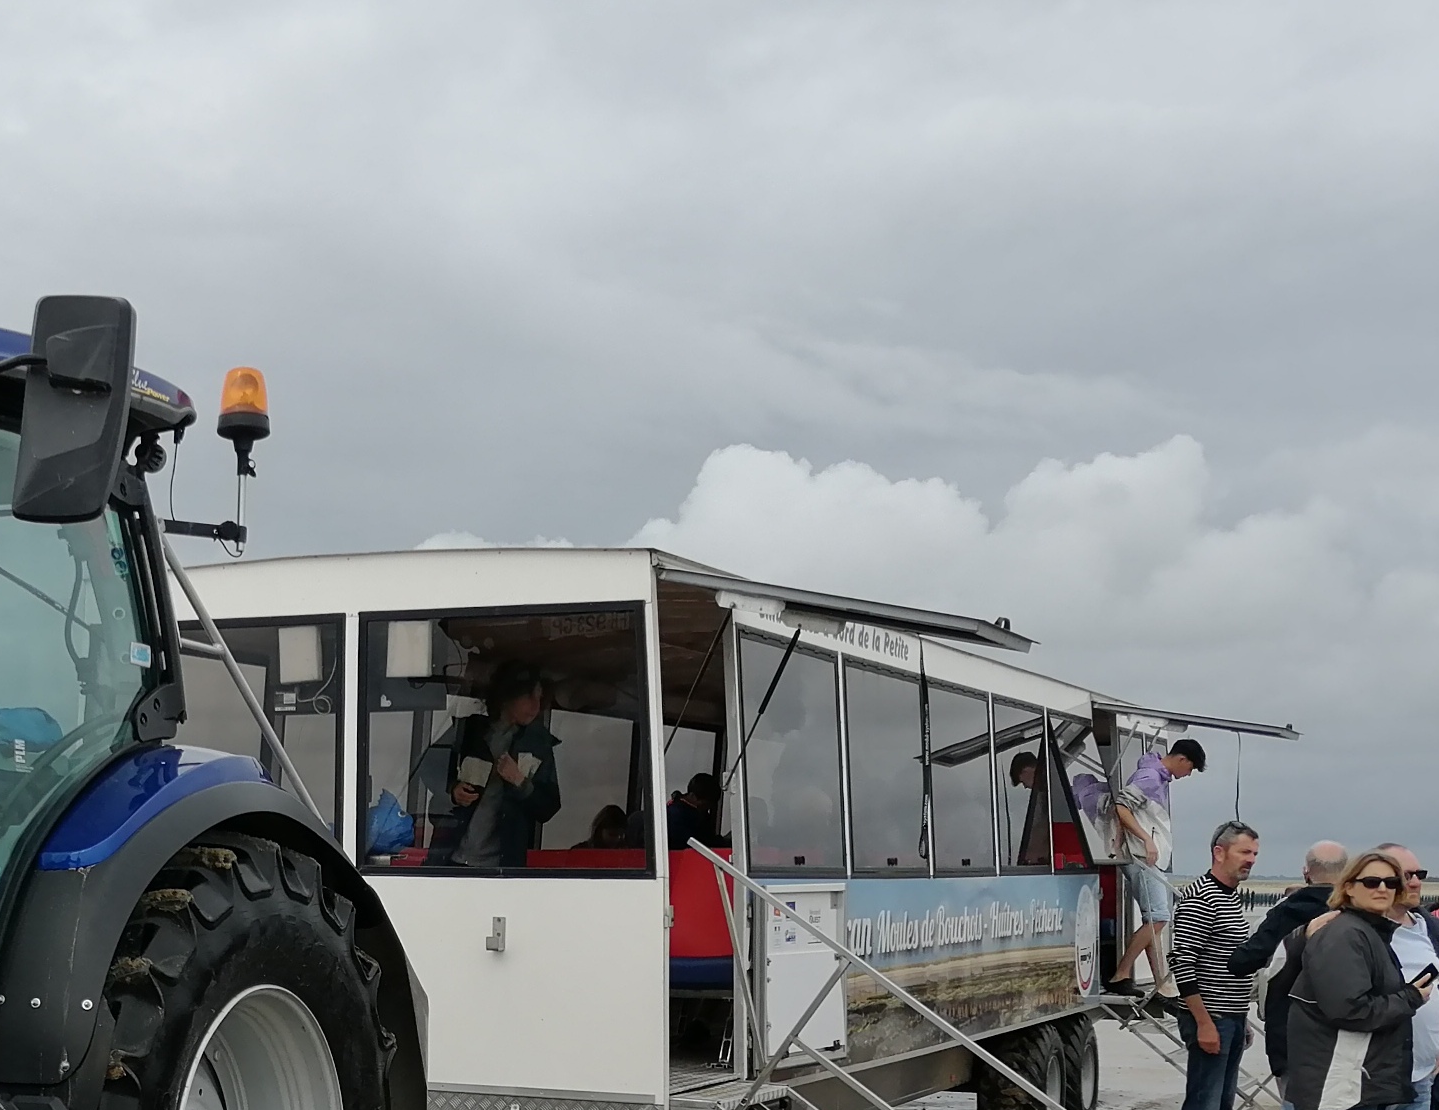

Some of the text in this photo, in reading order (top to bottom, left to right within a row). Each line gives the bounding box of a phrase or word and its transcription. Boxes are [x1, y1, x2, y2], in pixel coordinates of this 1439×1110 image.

[833, 622, 855, 646] ord
[858, 624, 870, 649] de
[872, 628, 881, 653] la
[884, 632, 909, 661] Petite
[877, 909, 919, 954] Moules
[921, 909, 935, 948] de
[936, 905, 982, 946] Bouchots
